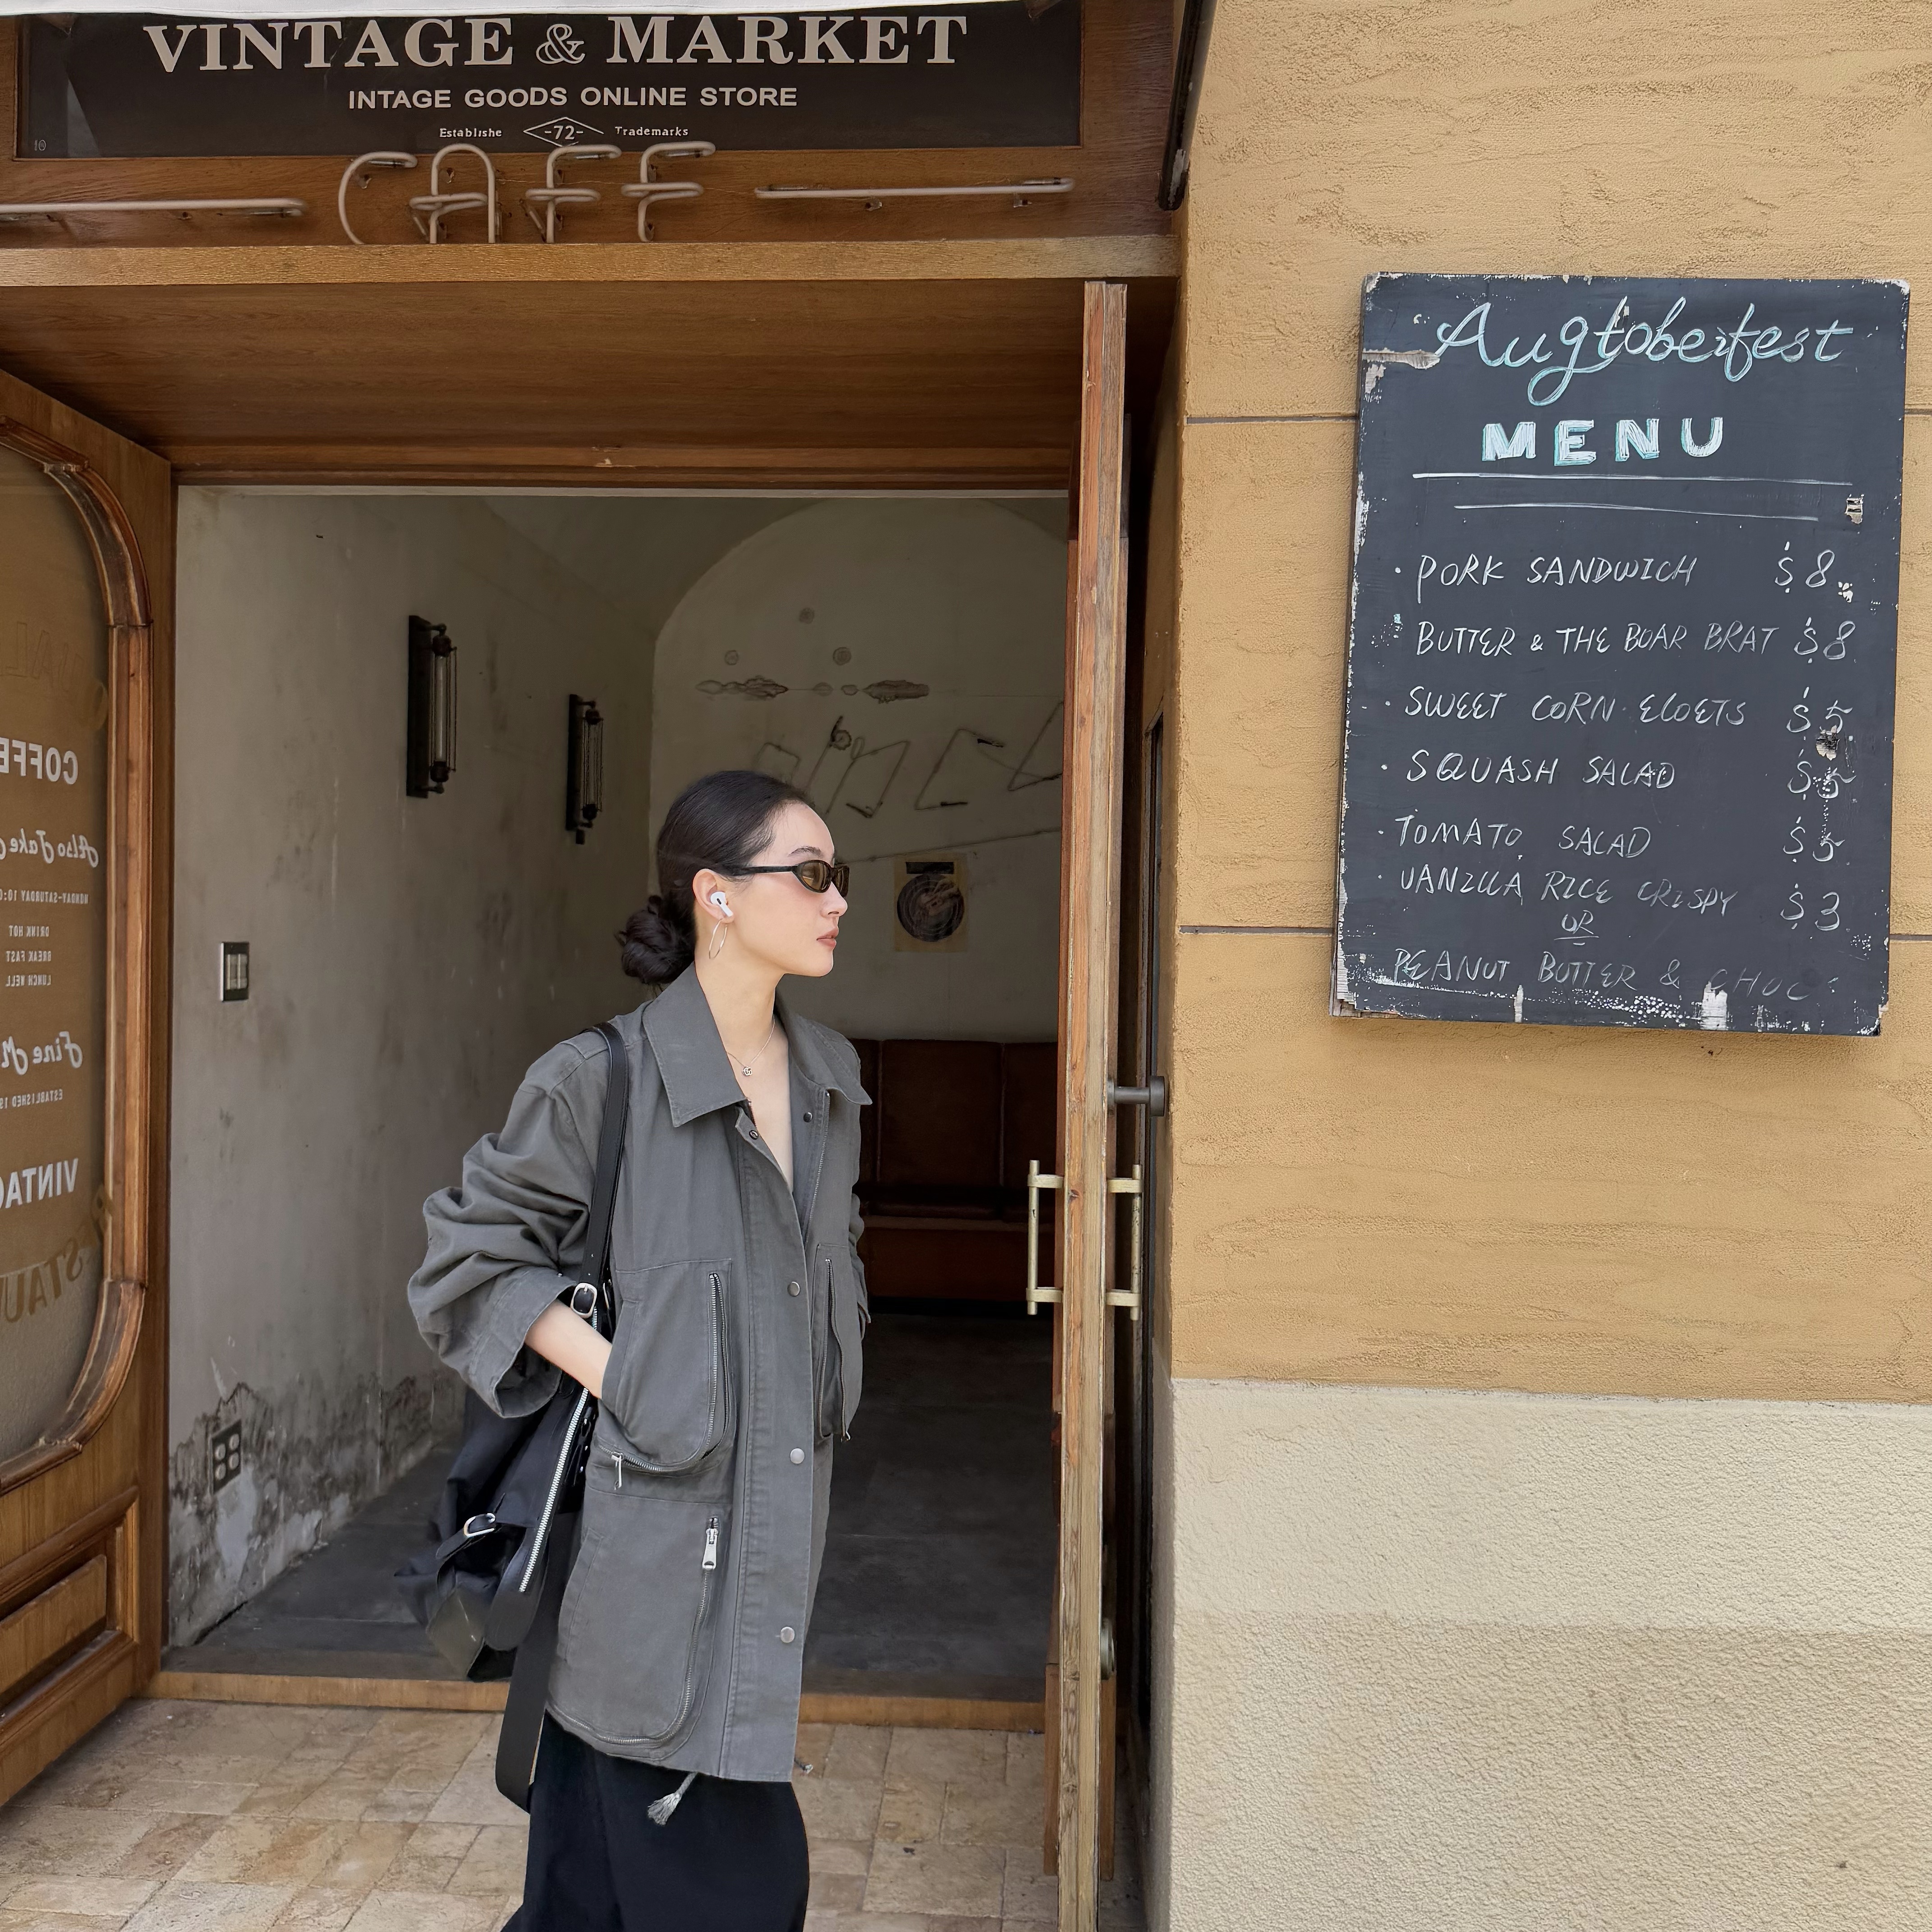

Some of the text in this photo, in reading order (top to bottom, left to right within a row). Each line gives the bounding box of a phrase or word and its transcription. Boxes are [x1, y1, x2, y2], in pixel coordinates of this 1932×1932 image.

[143, 16, 968, 73] VINTAGE & MARKET
[349, 87, 797, 109] INTAGE GOODS ONLINE STORE
[615, 126, 689, 137] Trademarks
[1481, 417, 1724, 466] MENU
[1416, 553, 1504, 604] PORK
[1527, 555, 1697, 586] SANDWICH
[1416, 621, 1515, 656] BUTTER
[1530, 634, 1544, 651] &
[1555, 626, 1611, 654] THE
[1624, 623, 1687, 652] BOAR
[1704, 620, 1780, 654] BRAT
[1405, 685, 1507, 719] SWEET
[1532, 691, 1616, 724] CORN
[1406, 749, 1559, 784] SQUASH
[1582, 756, 1675, 789] SALAD
[1395, 815, 1523, 849] TOMATO
[1559, 825, 1651, 858] SALAD
[1540, 870, 1614, 904] RICE
[1637, 879, 1738, 917] CRISPY
[1561, 910, 1594, 934] OR
[1394, 948, 1510, 983] PEANUT
[1538, 951, 1638, 991] BUTTER
[1659, 959, 1680, 989] &
